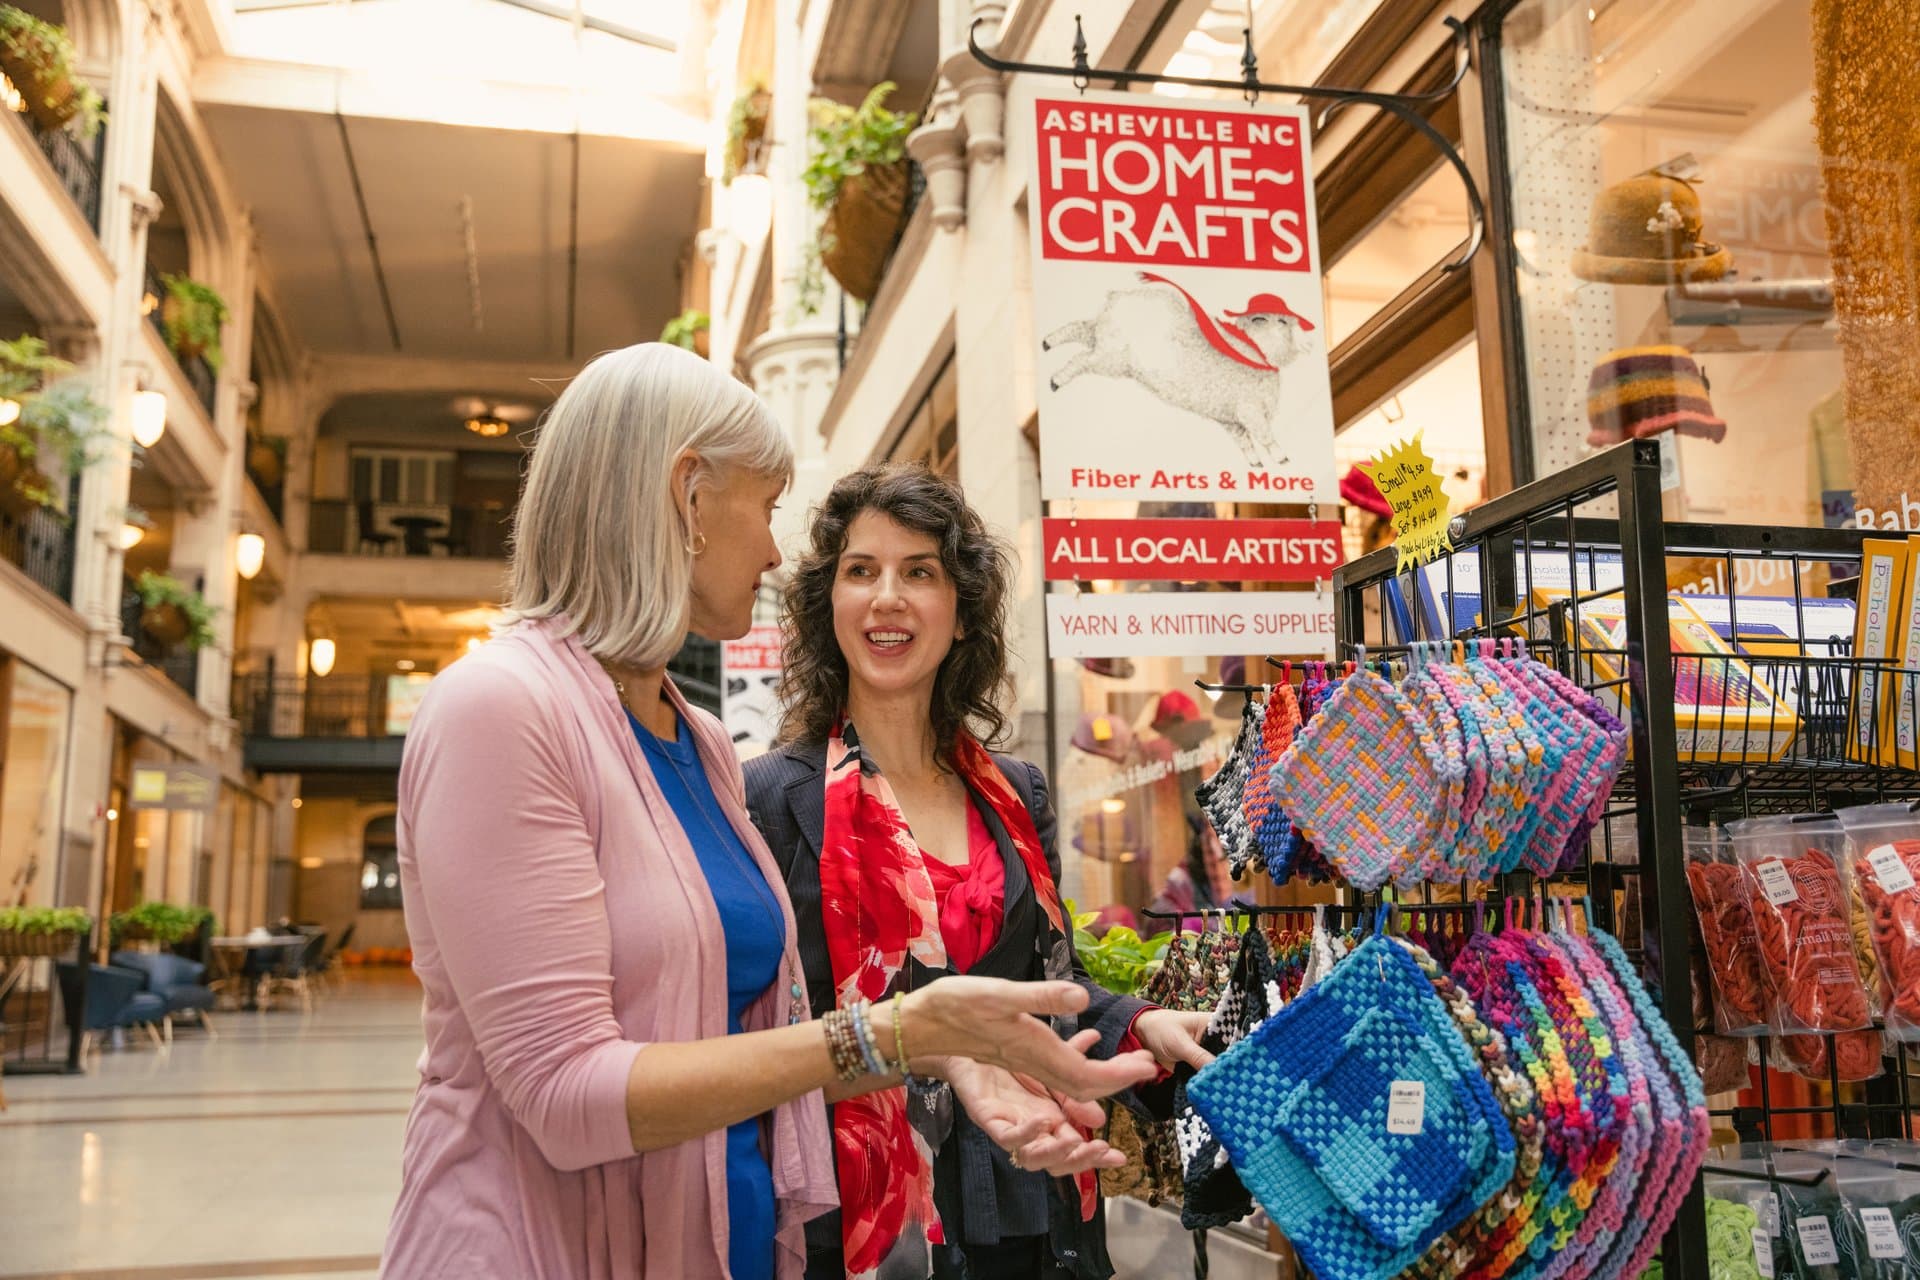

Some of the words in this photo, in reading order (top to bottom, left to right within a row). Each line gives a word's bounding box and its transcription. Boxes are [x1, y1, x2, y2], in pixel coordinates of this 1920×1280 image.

[1043, 109, 1233, 142] ASHEVILLE
[1248, 123, 1294, 146] NC
[1049, 197, 1303, 264] CRAFTS
[1071, 468, 1141, 488] Fiber
[1150, 470, 1209, 489] Arts
[1219, 471, 1237, 489] &
[1249, 471, 1314, 491] More
[1377, 467, 1407, 493] Small
[1412, 485, 1434, 505] $9.99
[1051, 536, 1109, 564] ALL
[1116, 537, 1217, 564] LOCAL
[1223, 538, 1338, 564] ARTISTS
[1867, 563, 1887, 659] Potholde
[1060, 614, 1117, 636] YARN
[1127, 614, 1143, 635] &
[1152, 613, 1245, 635] KNITTING
[1254, 613, 1336, 634] SUPPLIES
[1795, 930, 1829, 946] small
